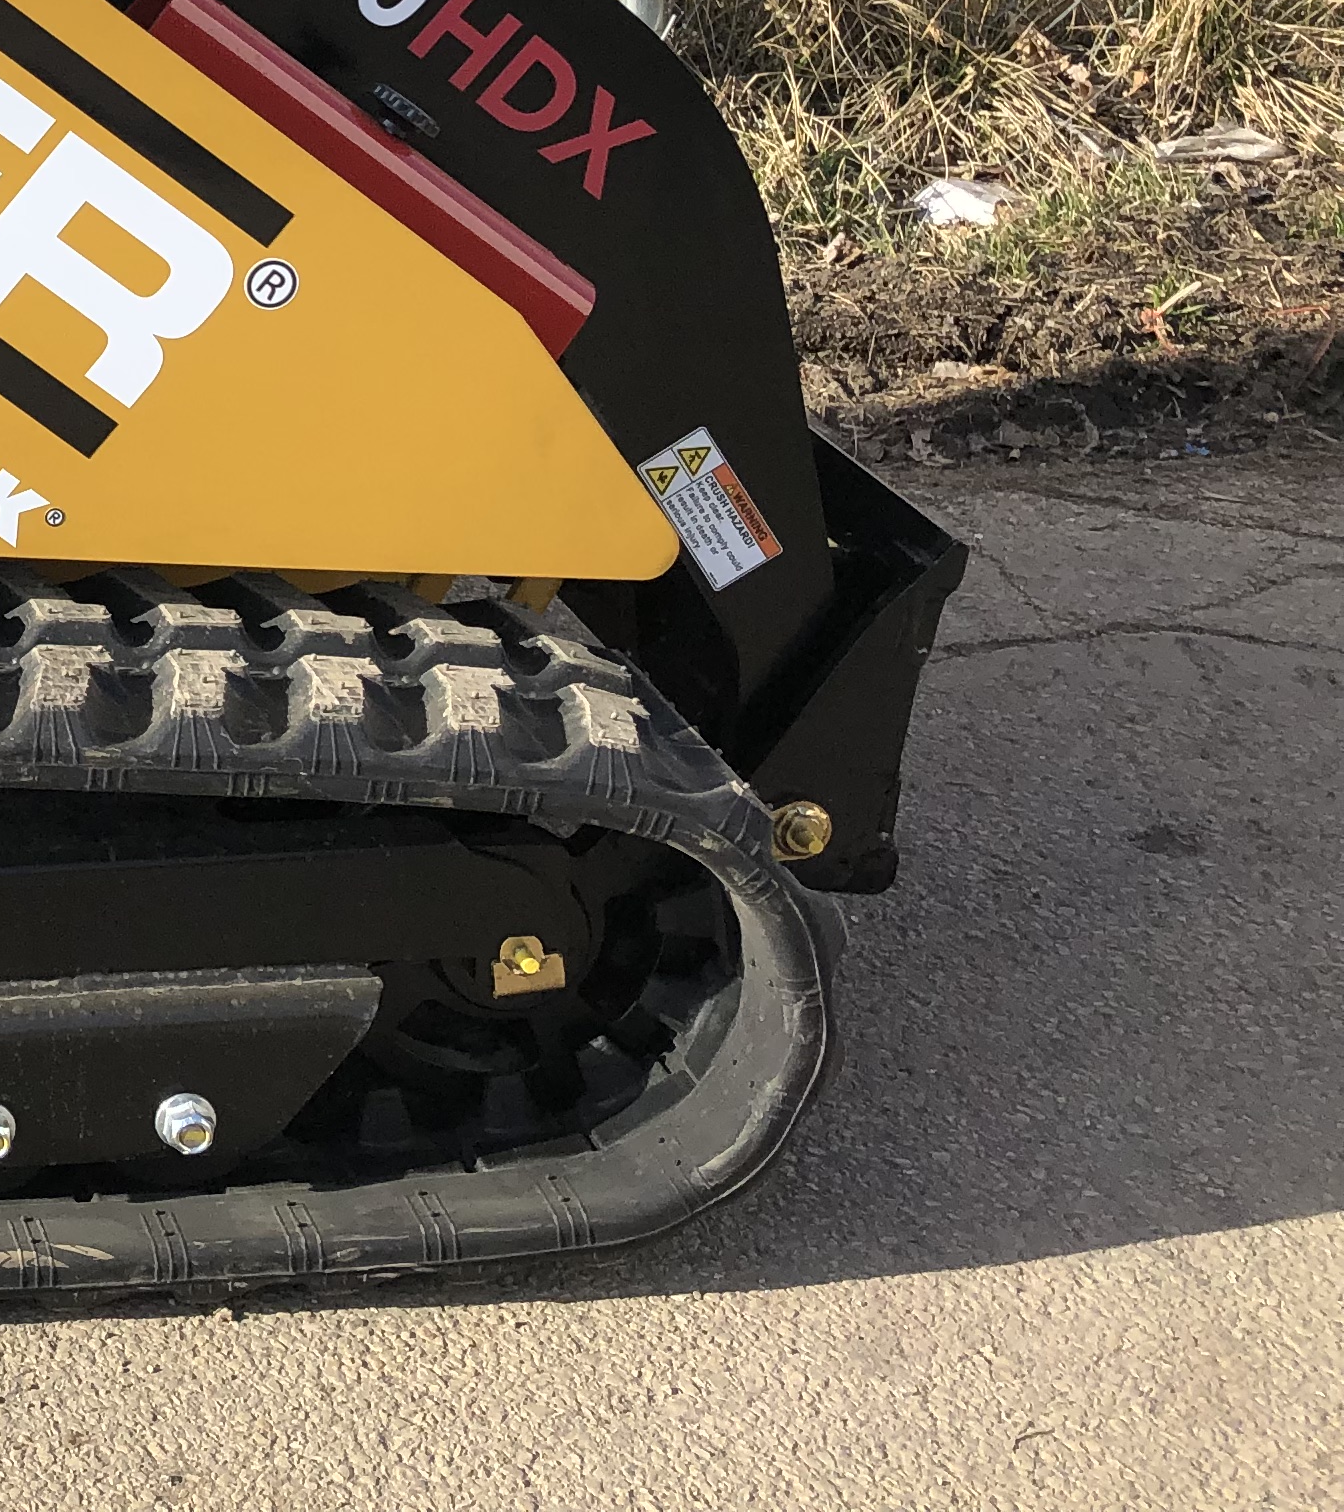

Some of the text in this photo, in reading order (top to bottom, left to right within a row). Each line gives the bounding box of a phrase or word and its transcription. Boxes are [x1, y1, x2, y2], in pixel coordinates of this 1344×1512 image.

[666, 499, 687, 528] serious
[695, 481, 711, 502] Keep
[704, 475, 756, 549] CRUSH HAZARD!
[732, 491, 769, 542] WARNING
[675, 493, 694, 516] result
[691, 515, 699, 525] in
[695, 523, 713, 547] death
[710, 545, 720, 555] or
[685, 487, 705, 518] Failure
[702, 513, 712, 523] to
[708, 524, 730, 551] comply
[726, 549, 744, 572] could
